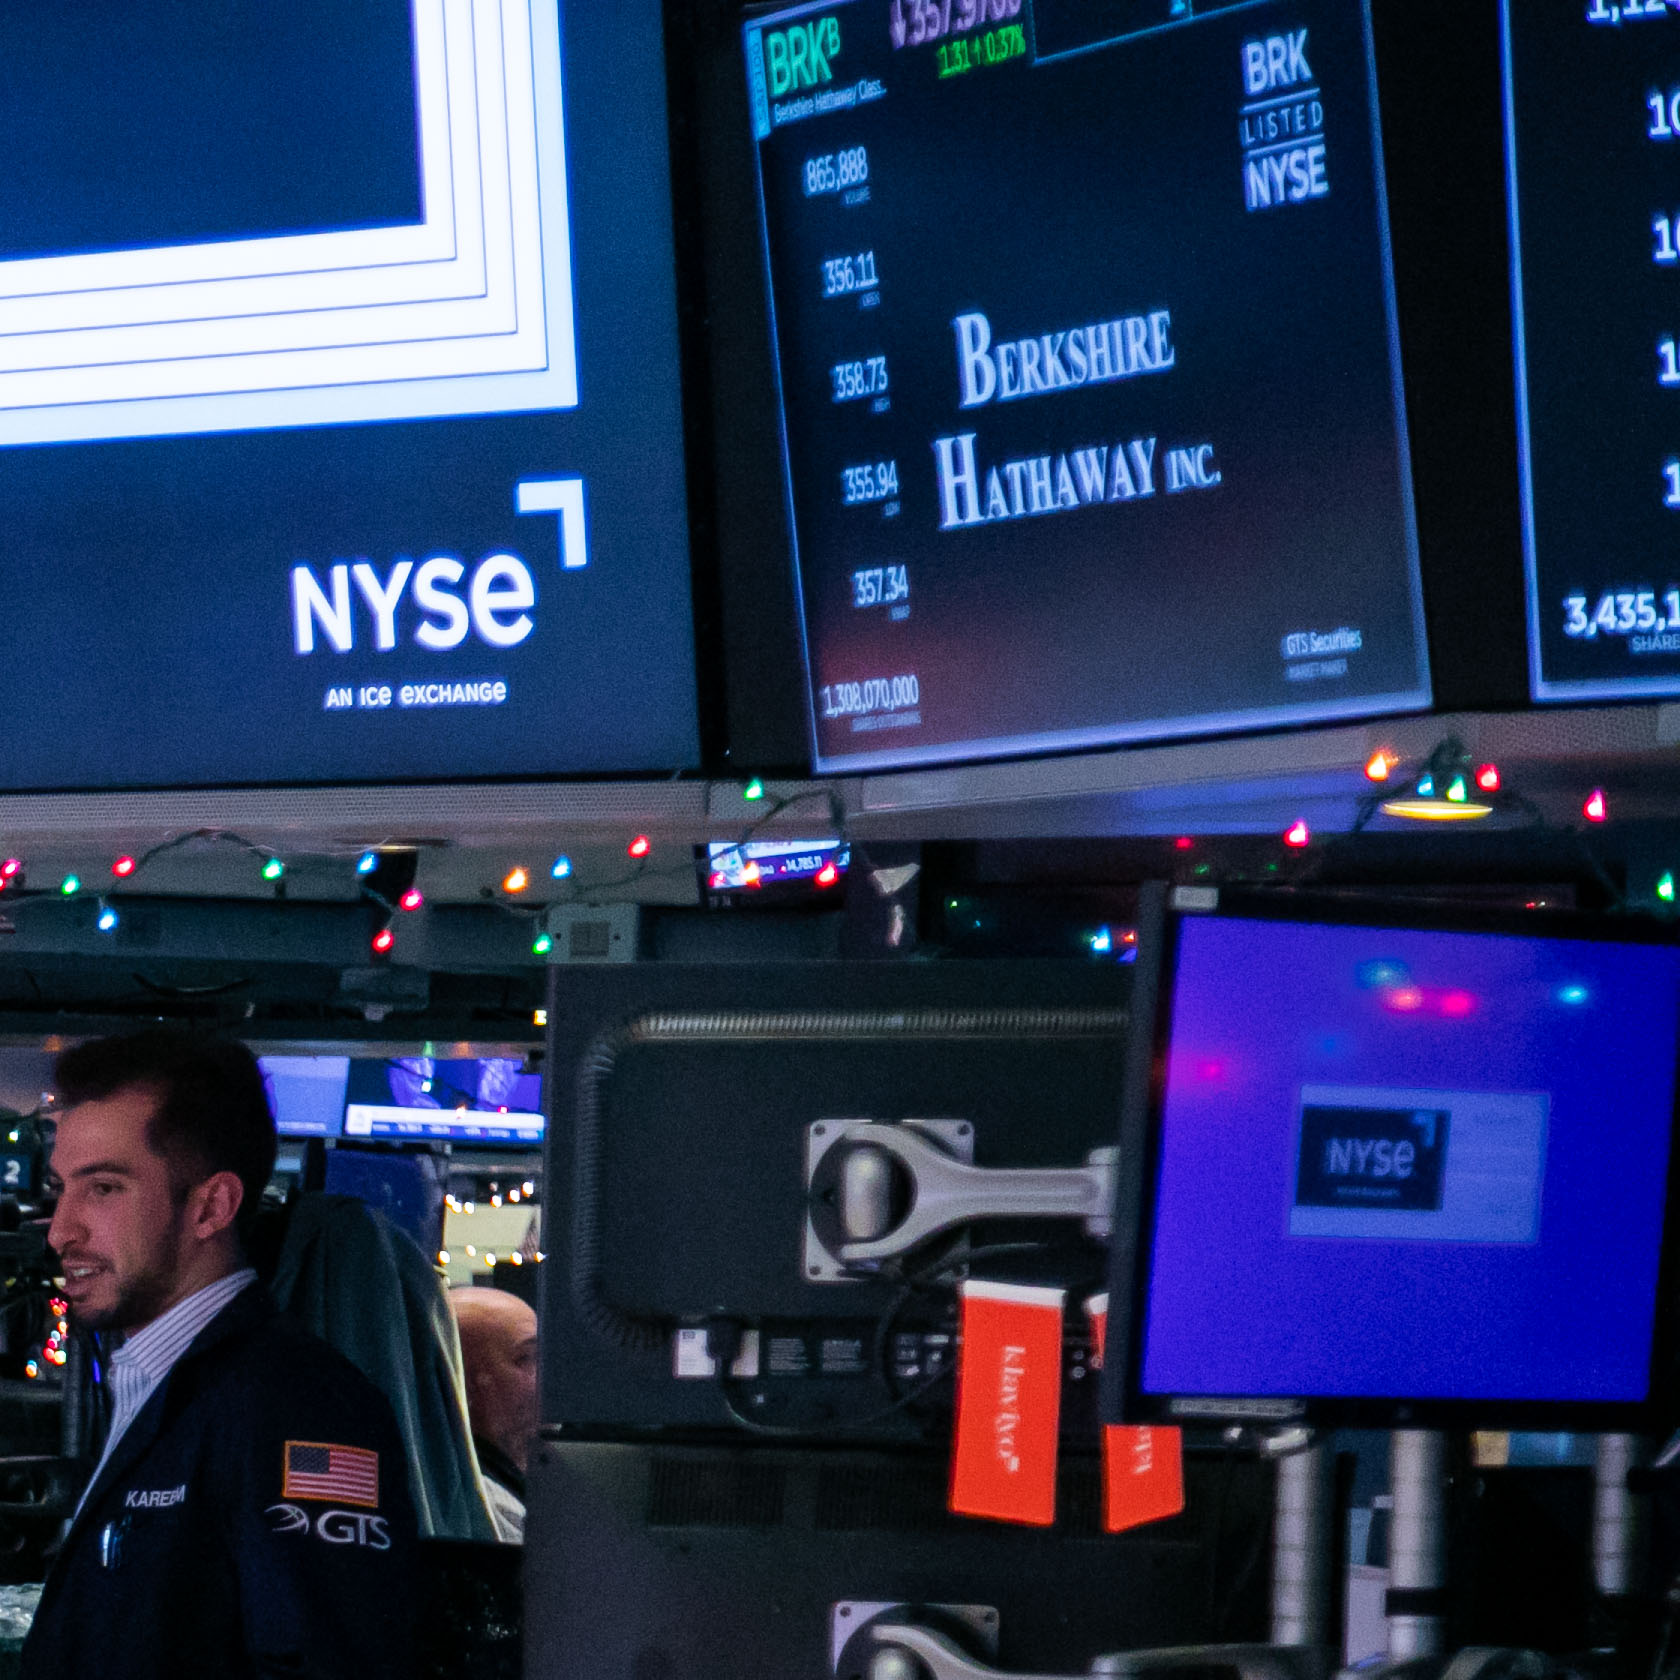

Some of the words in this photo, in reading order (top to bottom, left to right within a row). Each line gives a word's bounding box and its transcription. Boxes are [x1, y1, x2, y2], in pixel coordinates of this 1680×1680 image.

[1246, 28, 1312, 94] BRK
[1244, 101, 1324, 145] LISTED
[806, 146, 868, 193] 865,888
[1247, 143, 1329, 209] NYSE
[824, 251, 879, 294] 356.11
[835, 356, 888, 399] 358.73
[955, 310, 1175, 408] BERKSHIRE
[845, 460, 898, 501] 355.94
[936, 433, 1156, 528] HATHAWAY
[1168, 444, 1222, 491] INC.
[854, 564, 909, 605] 357.34
[1286, 632, 1308, 655] GTS
[1310, 626, 1362, 652] Securities
[326, 687, 353, 708] AN
[823, 674, 919, 717] 1,308,070,000
[3, 1159, 20, 1184] 2
[316, 1509, 392, 1551] GTS
